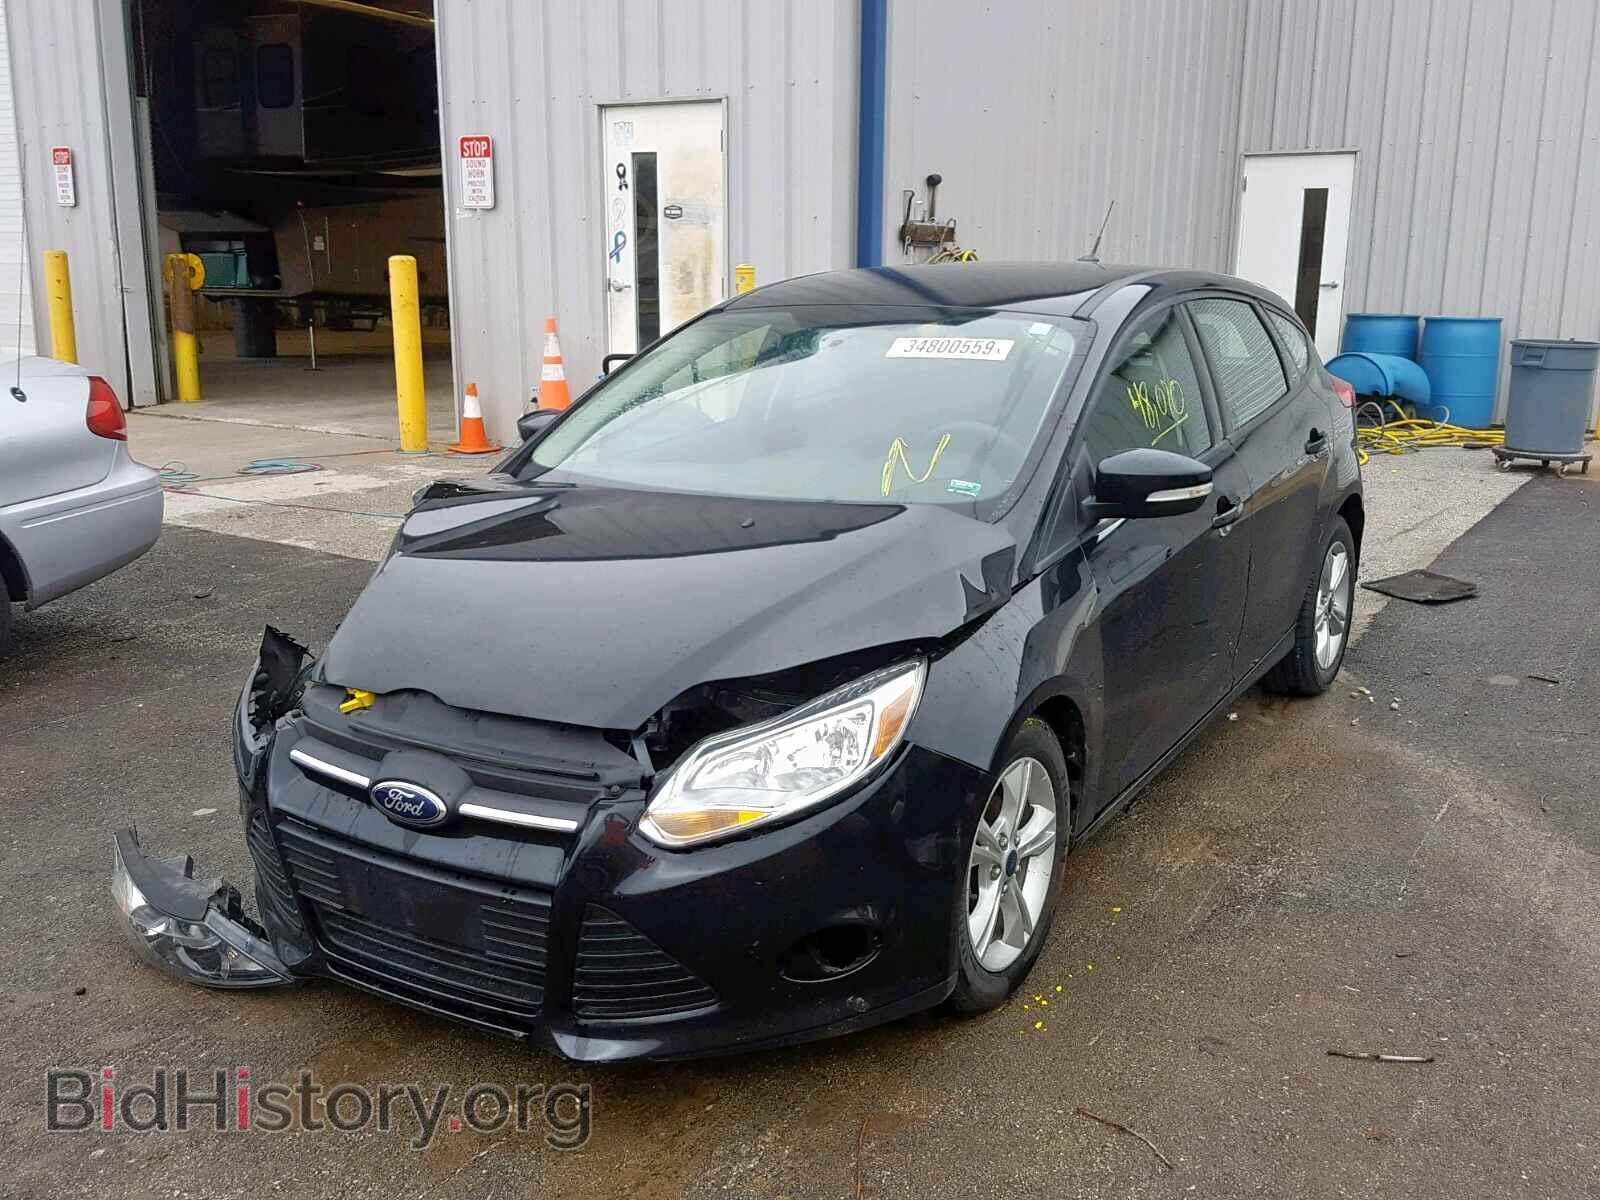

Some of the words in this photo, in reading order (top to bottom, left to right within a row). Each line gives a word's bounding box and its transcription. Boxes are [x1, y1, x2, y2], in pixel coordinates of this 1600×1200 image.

[463, 140, 489, 157] STOP
[465, 159, 487, 169] SOUND
[384, 788, 425, 816] Ford
